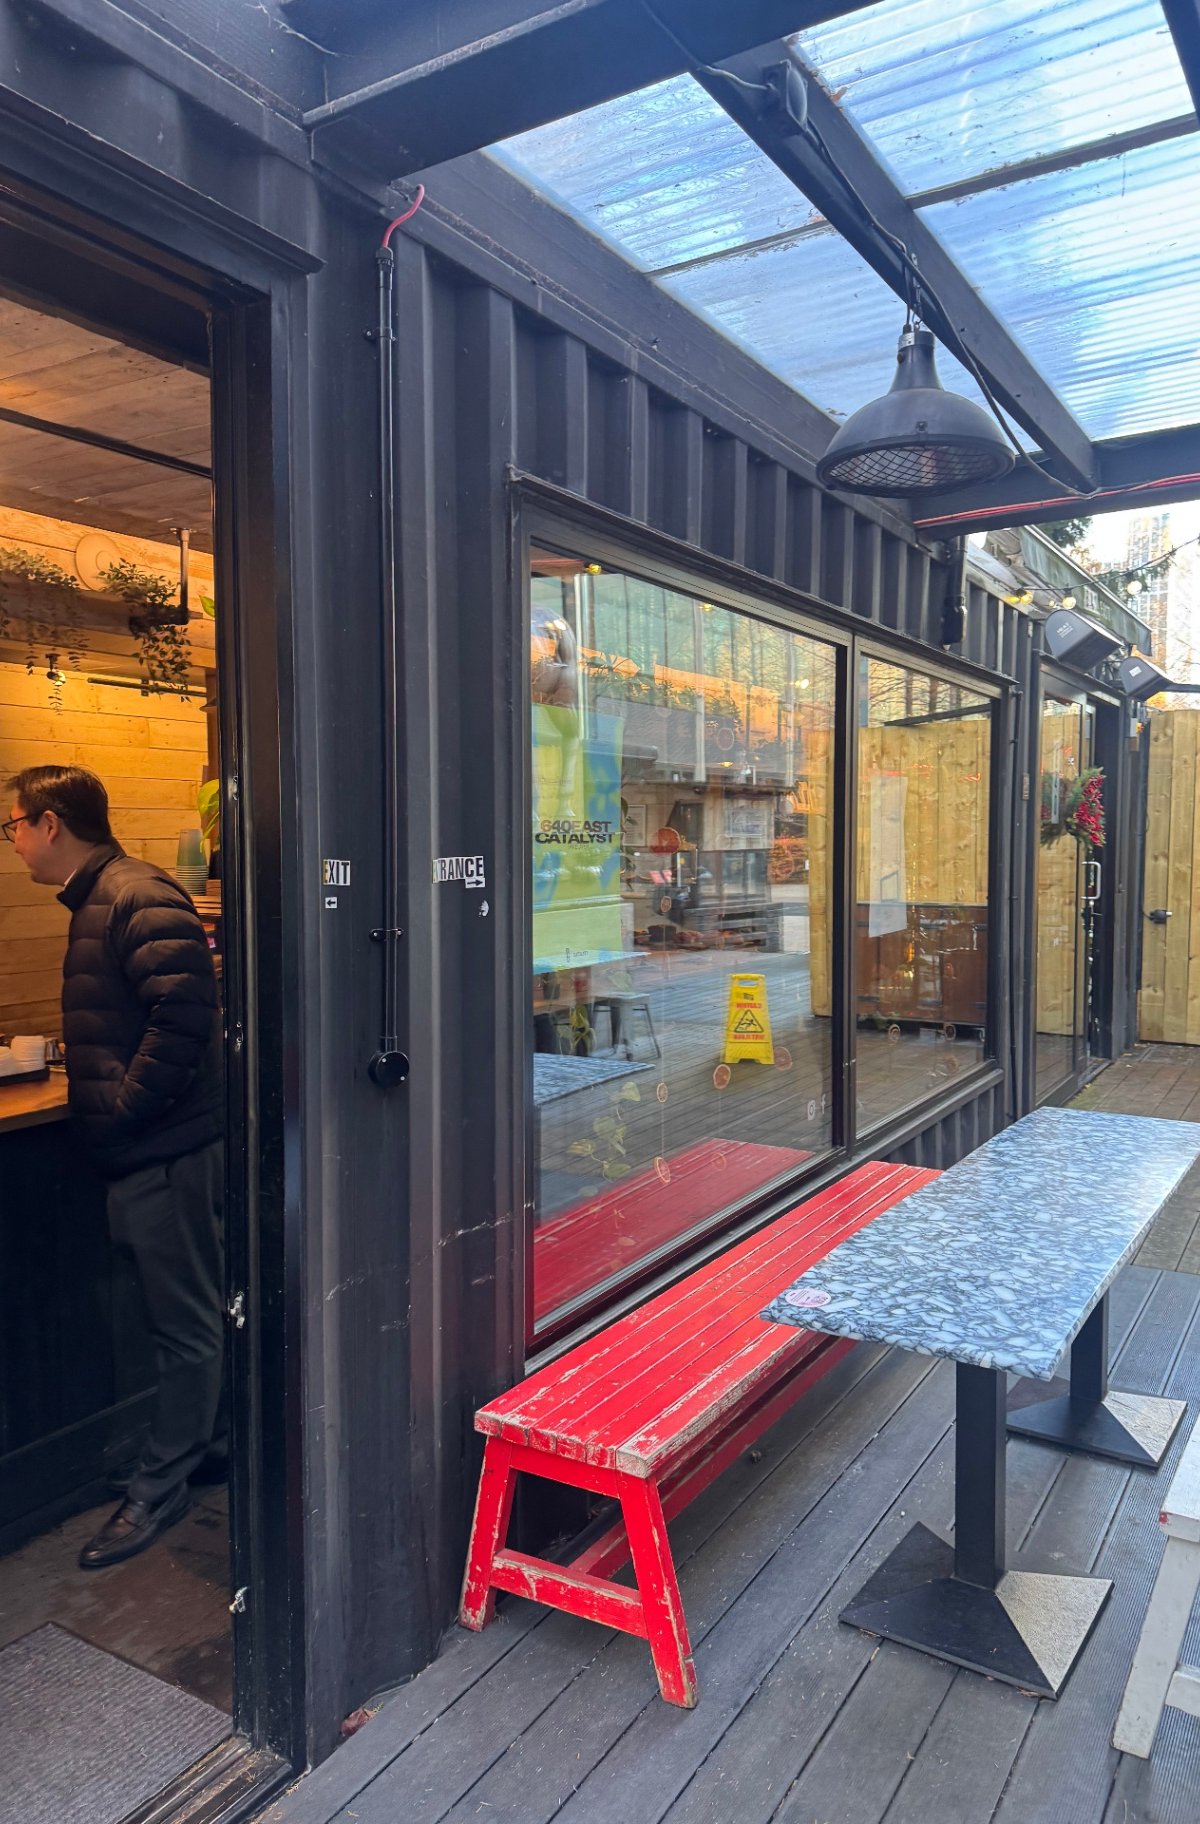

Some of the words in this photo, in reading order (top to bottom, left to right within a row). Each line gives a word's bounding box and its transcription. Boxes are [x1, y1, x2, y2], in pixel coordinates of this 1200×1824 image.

[535, 832, 614, 844] CATALYST
[324, 860, 350, 884] EXIT
[432, 857, 483, 882] ERANCE
